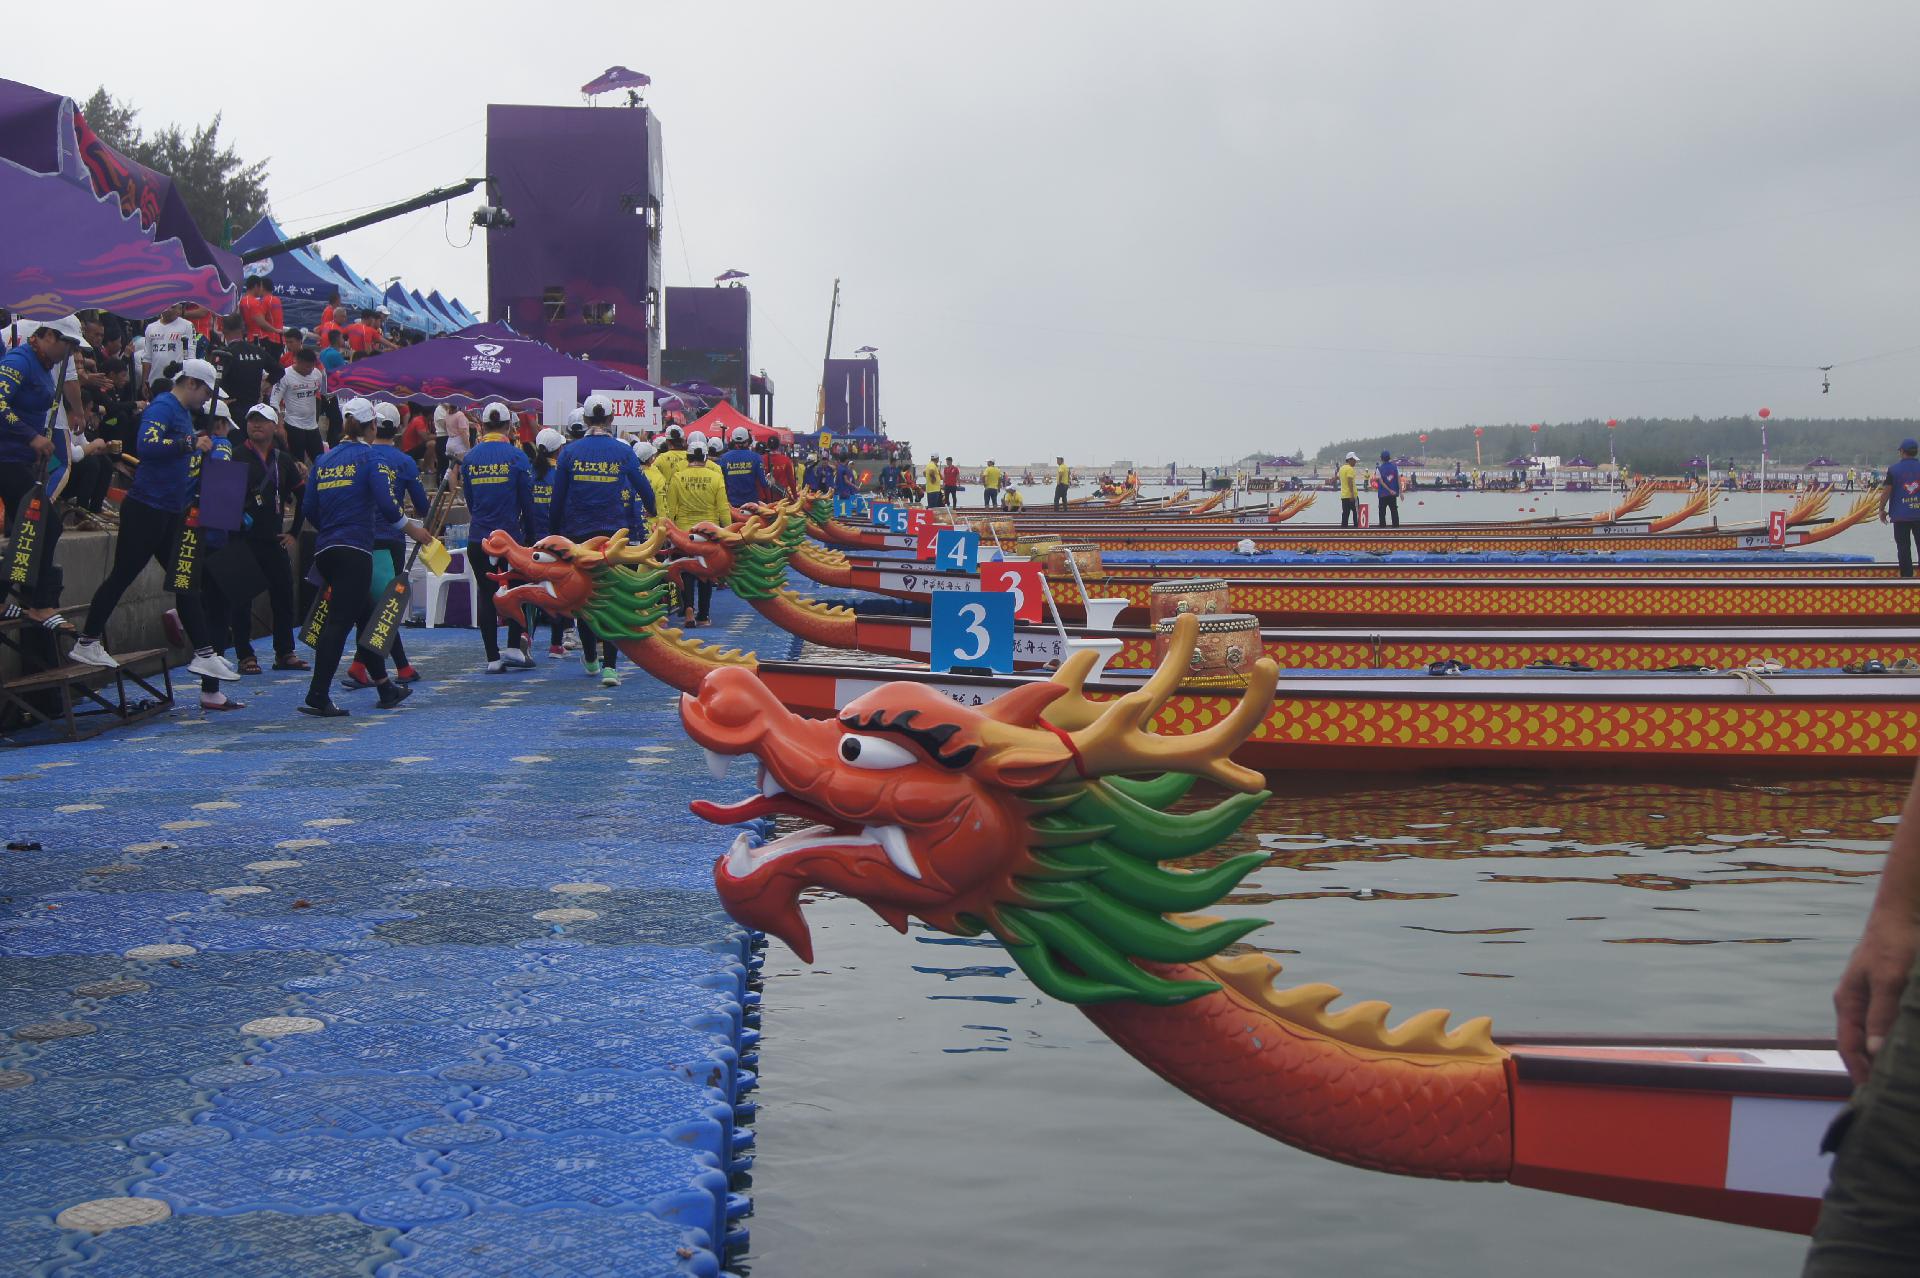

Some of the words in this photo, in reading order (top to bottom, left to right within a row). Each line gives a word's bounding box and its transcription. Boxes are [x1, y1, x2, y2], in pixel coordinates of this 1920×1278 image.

[877, 506, 889, 523] 6
[897, 512, 908, 531] 5
[914, 513, 926, 531] 5
[1360, 506, 1366, 527] 6
[1773, 515, 1782, 541] 5
[10, 520, 36, 583] 九江双蒸
[174, 529, 198, 590] 九江双蒸
[948, 536, 968, 567] 4
[1000, 570, 1025, 613] 3
[305, 599, 329, 646] 九江双蒸
[369, 597, 399, 650] 九江双蒸
[953, 603, 990, 661] 3
